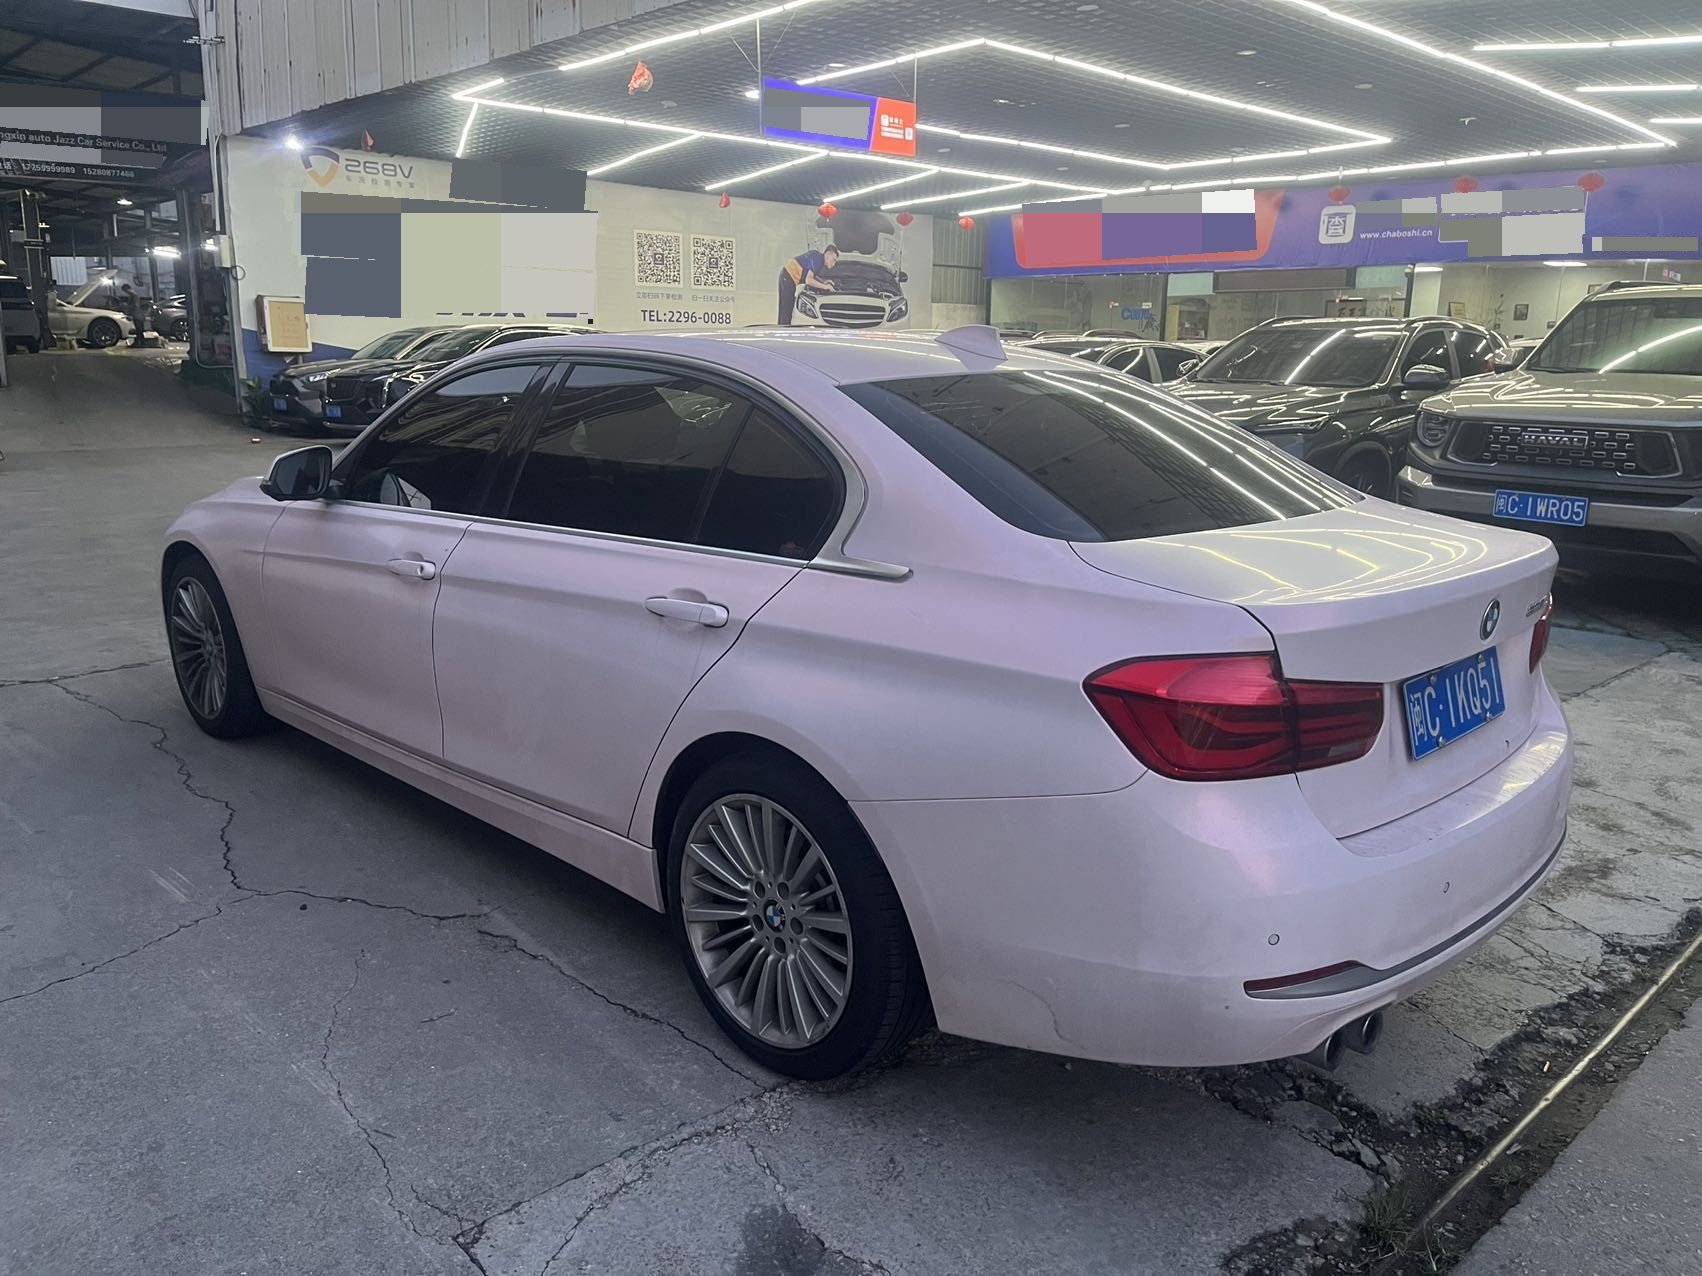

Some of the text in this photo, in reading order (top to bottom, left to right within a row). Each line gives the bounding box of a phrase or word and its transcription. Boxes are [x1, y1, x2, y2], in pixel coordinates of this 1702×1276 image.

[29, 134, 50, 142] auto
[53, 135, 75, 144] Jazz
[77, 137, 93, 146] Car
[96, 138, 130, 149] Service
[344, 158, 413, 179] 268V
[1360, 229, 1433, 239] www.chaboshi.cn
[640, 309, 732, 325] TEL:2296-0088
[1524, 435, 1583, 446] HAVAL
